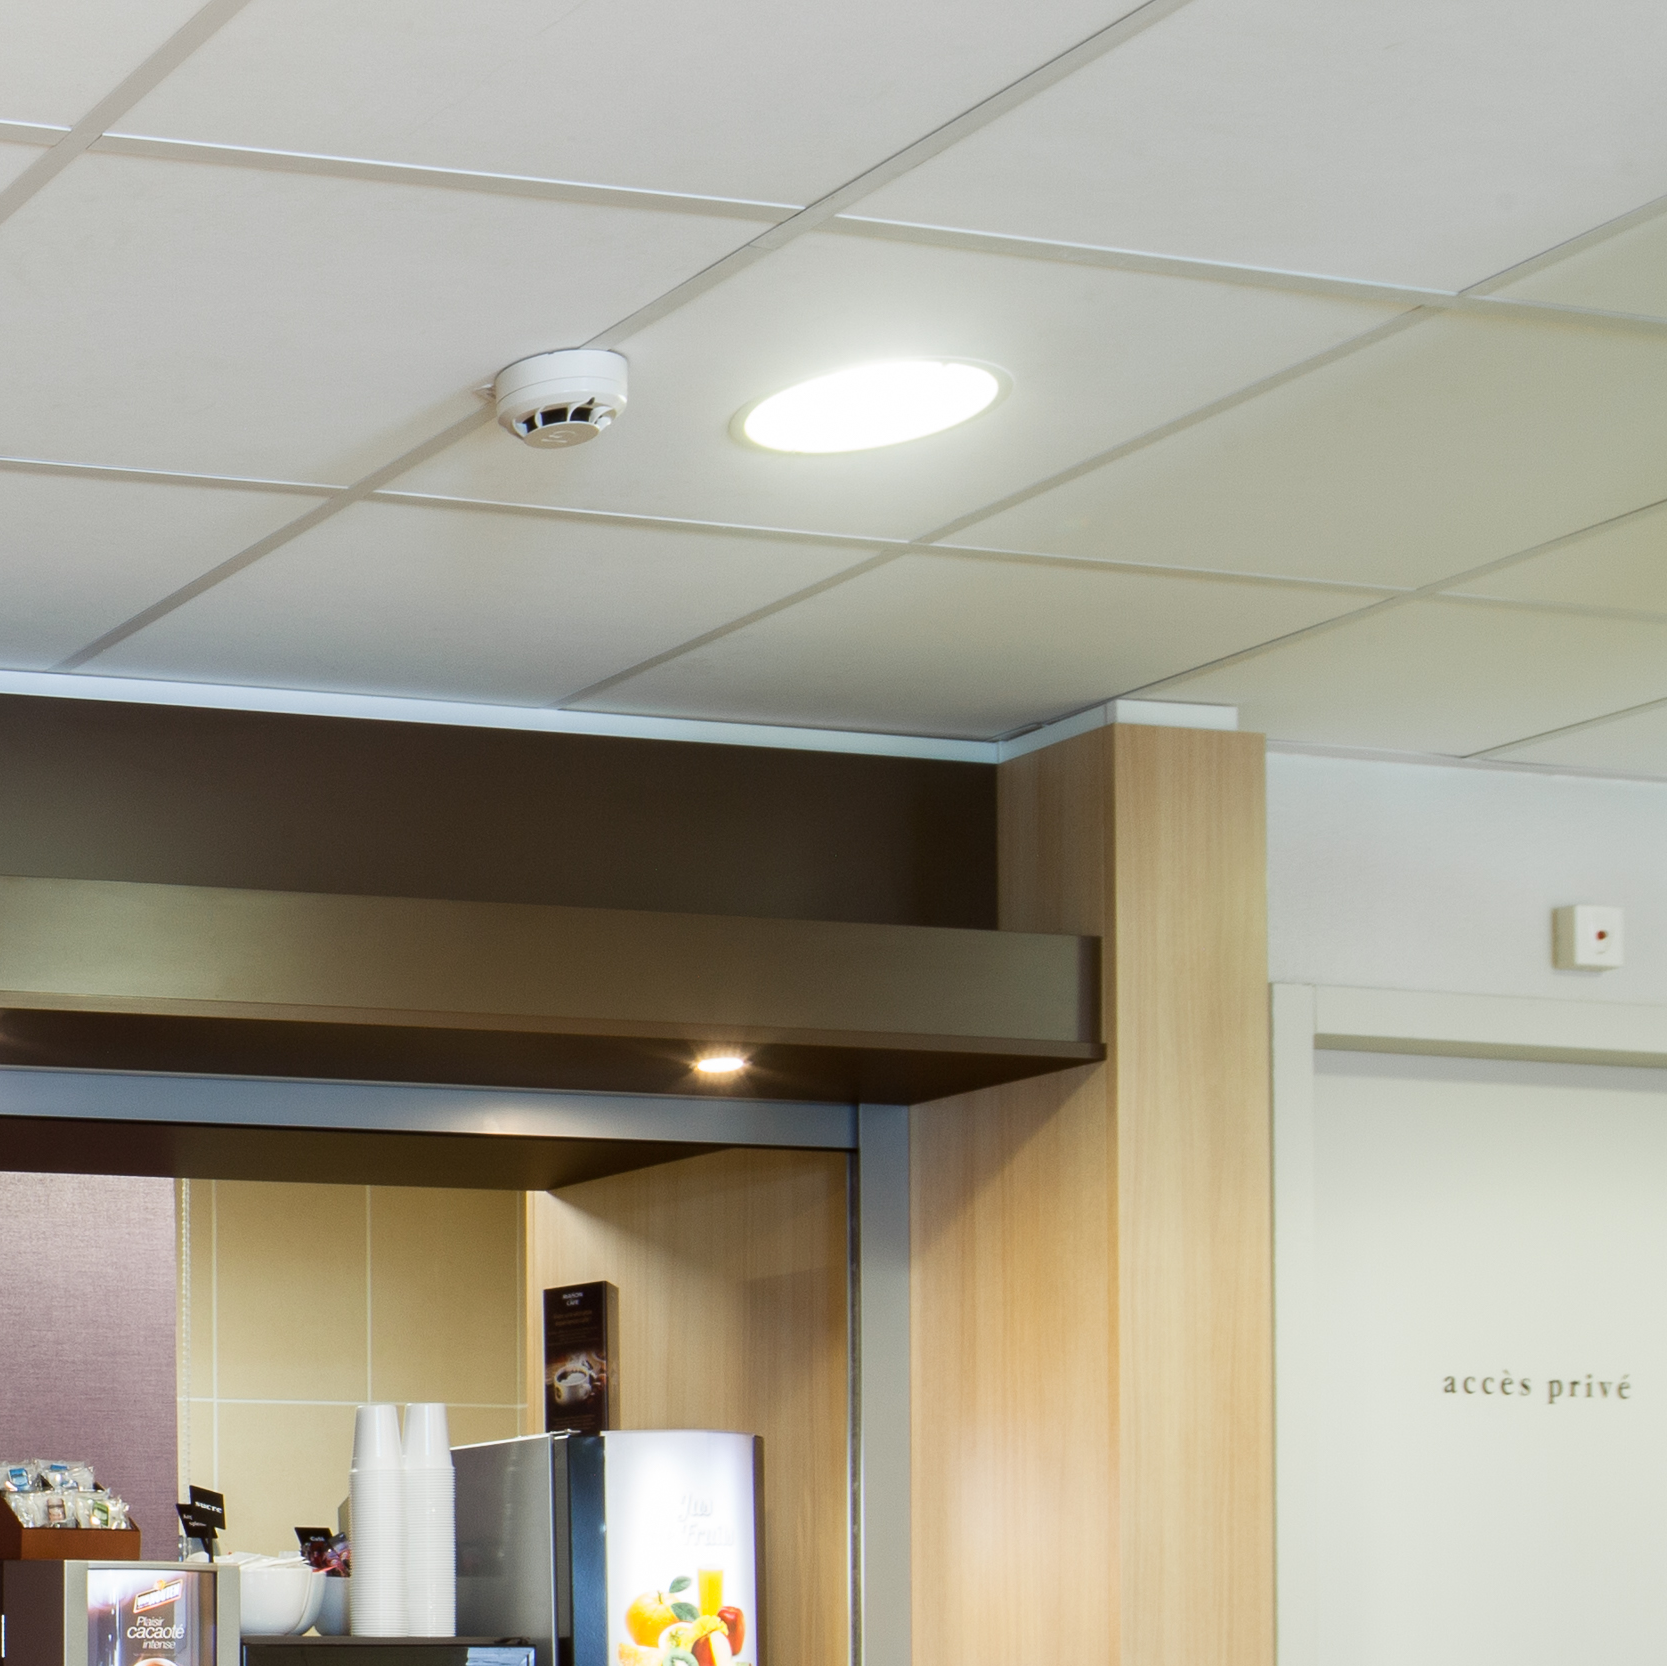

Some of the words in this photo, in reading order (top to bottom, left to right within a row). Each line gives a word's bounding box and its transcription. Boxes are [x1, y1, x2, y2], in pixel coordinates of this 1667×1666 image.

[1443, 1369, 1532, 1396] accès
[1547, 1373, 1632, 1405] privé
[194, 1501, 223, 1514] sucre
[136, 1616, 165, 1627] Plaisir
[127, 1624, 185, 1639] cacaoté
[142, 1640, 176, 1650] intense
